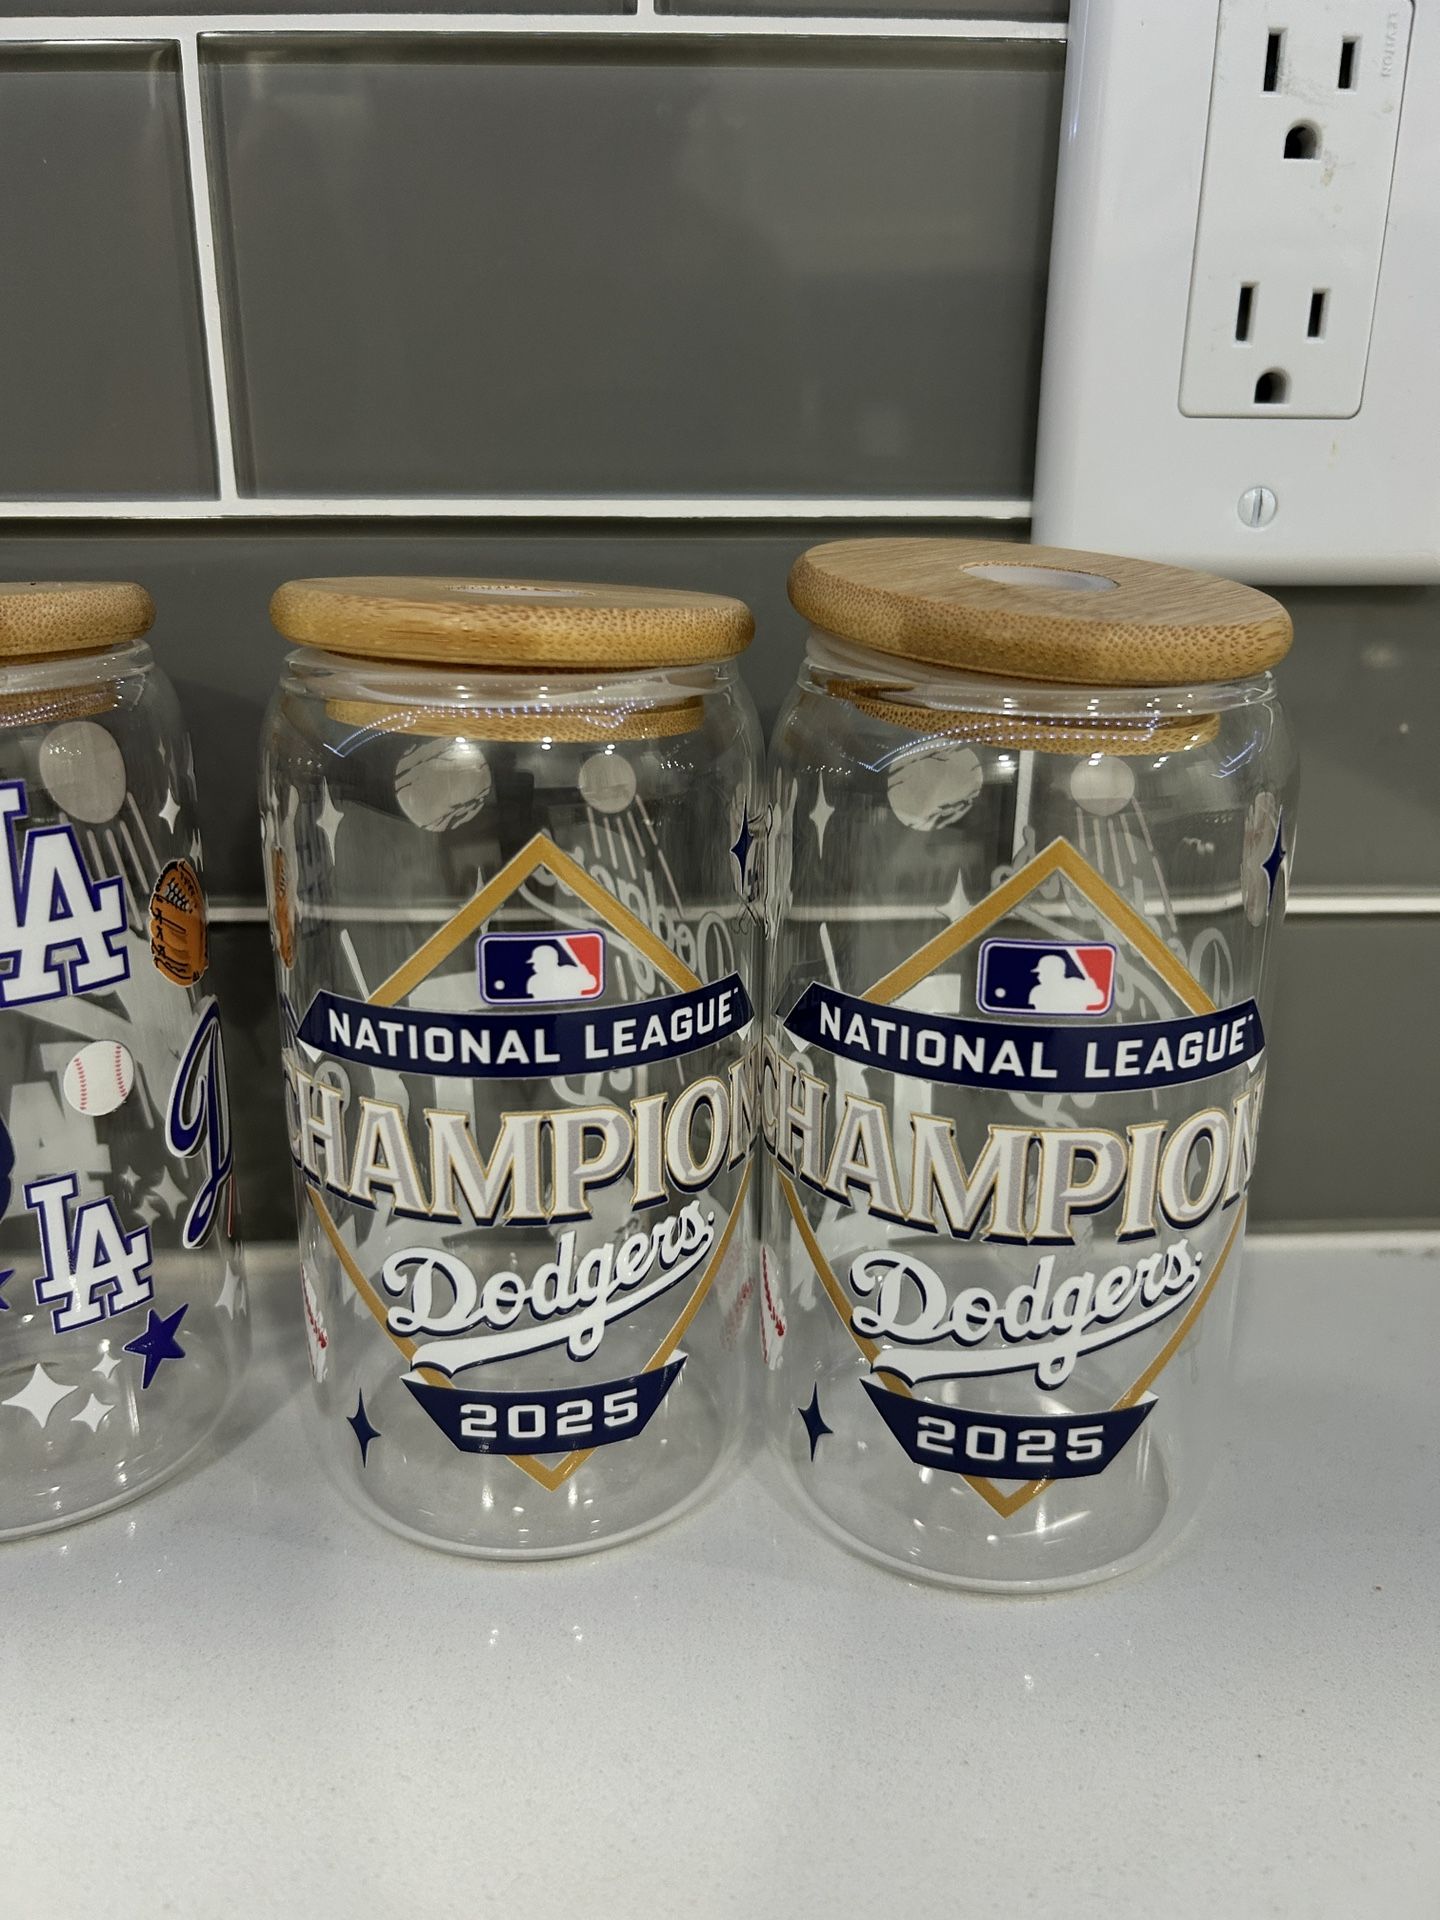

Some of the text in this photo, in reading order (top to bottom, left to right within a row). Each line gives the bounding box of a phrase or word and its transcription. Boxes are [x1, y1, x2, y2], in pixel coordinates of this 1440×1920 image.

[328, 1000, 733, 1065] NATIONAL LEAGUE
[820, 1001, 1246, 1079] NATIONAL LEAGUE
[22, 1172, 155, 1335] LA
[381, 1200, 715, 1364] Dodgers
[848, 1239, 1202, 1391] Dodgers
[459, 1387, 640, 1440] 2025
[916, 1415, 1105, 1465] 2025
